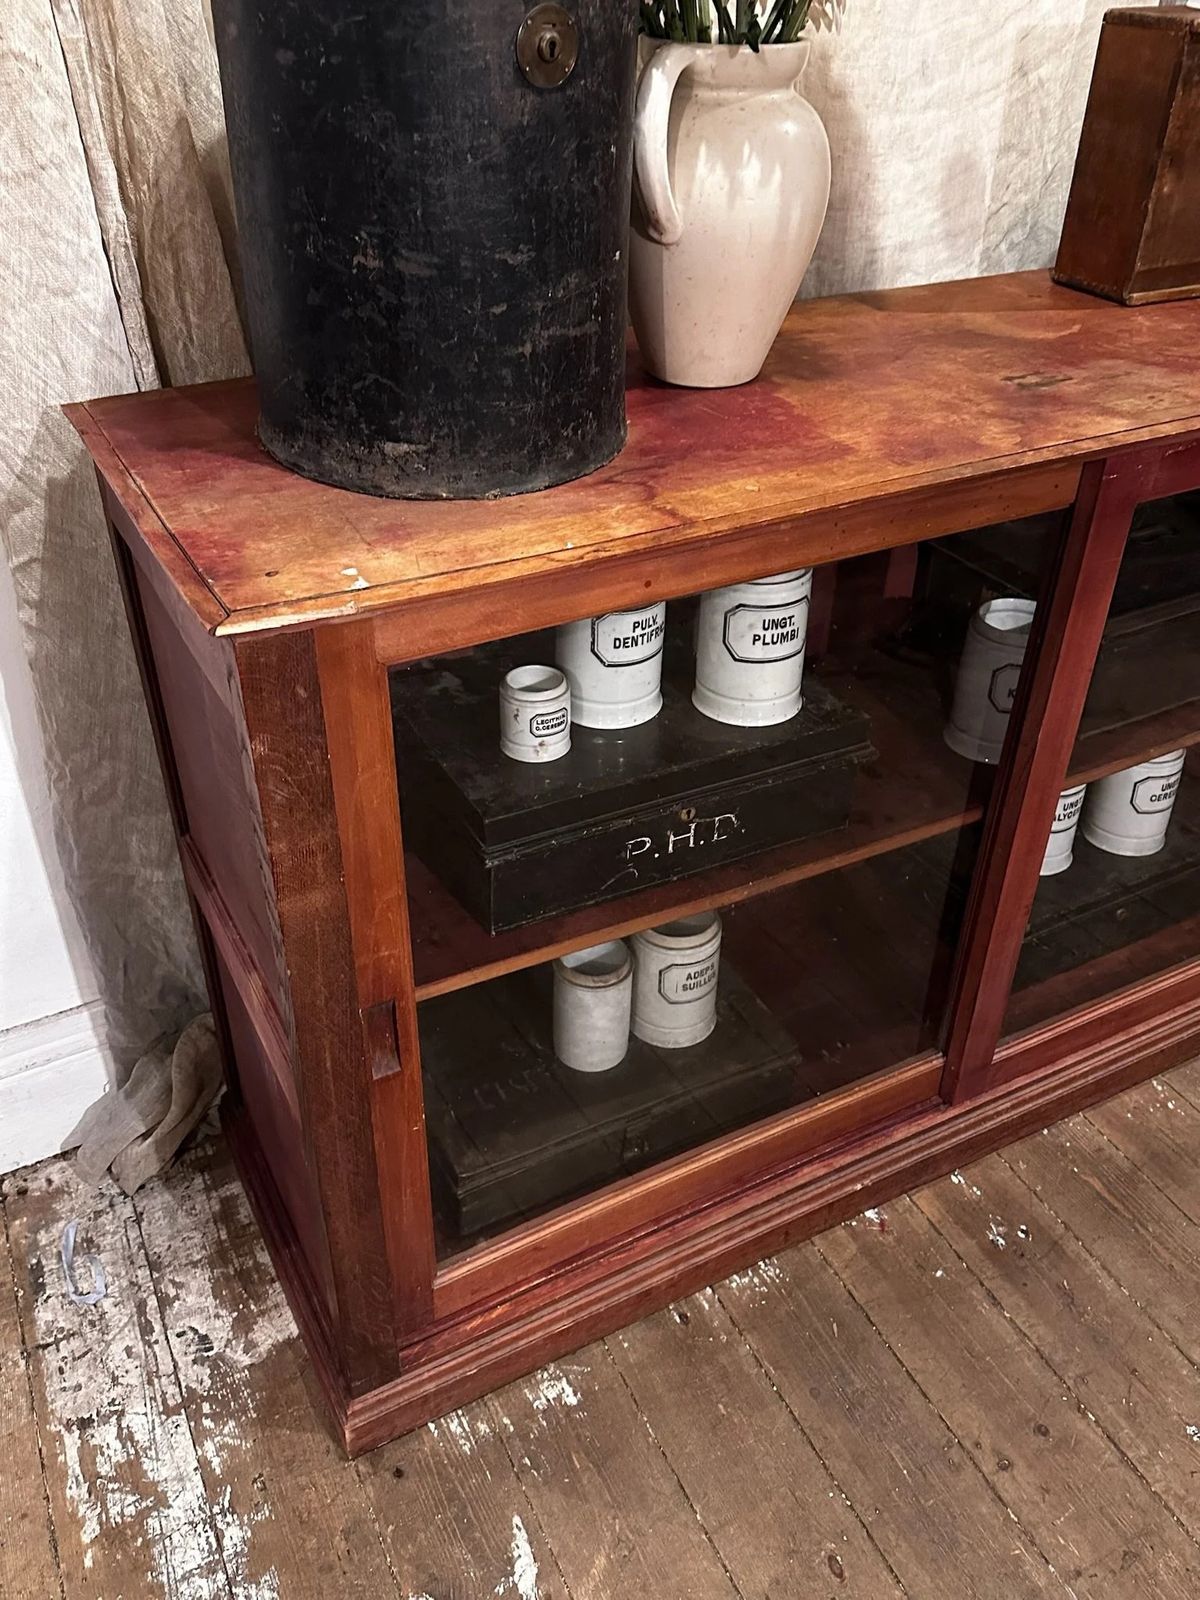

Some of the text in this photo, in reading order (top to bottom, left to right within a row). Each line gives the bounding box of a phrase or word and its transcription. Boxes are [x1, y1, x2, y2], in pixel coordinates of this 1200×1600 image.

[632, 614, 658, 633] PULV.
[762, 615, 795, 631] UNGT.
[752, 627, 800, 646] PLUMBI
[686, 962, 715, 981] ADEPS
